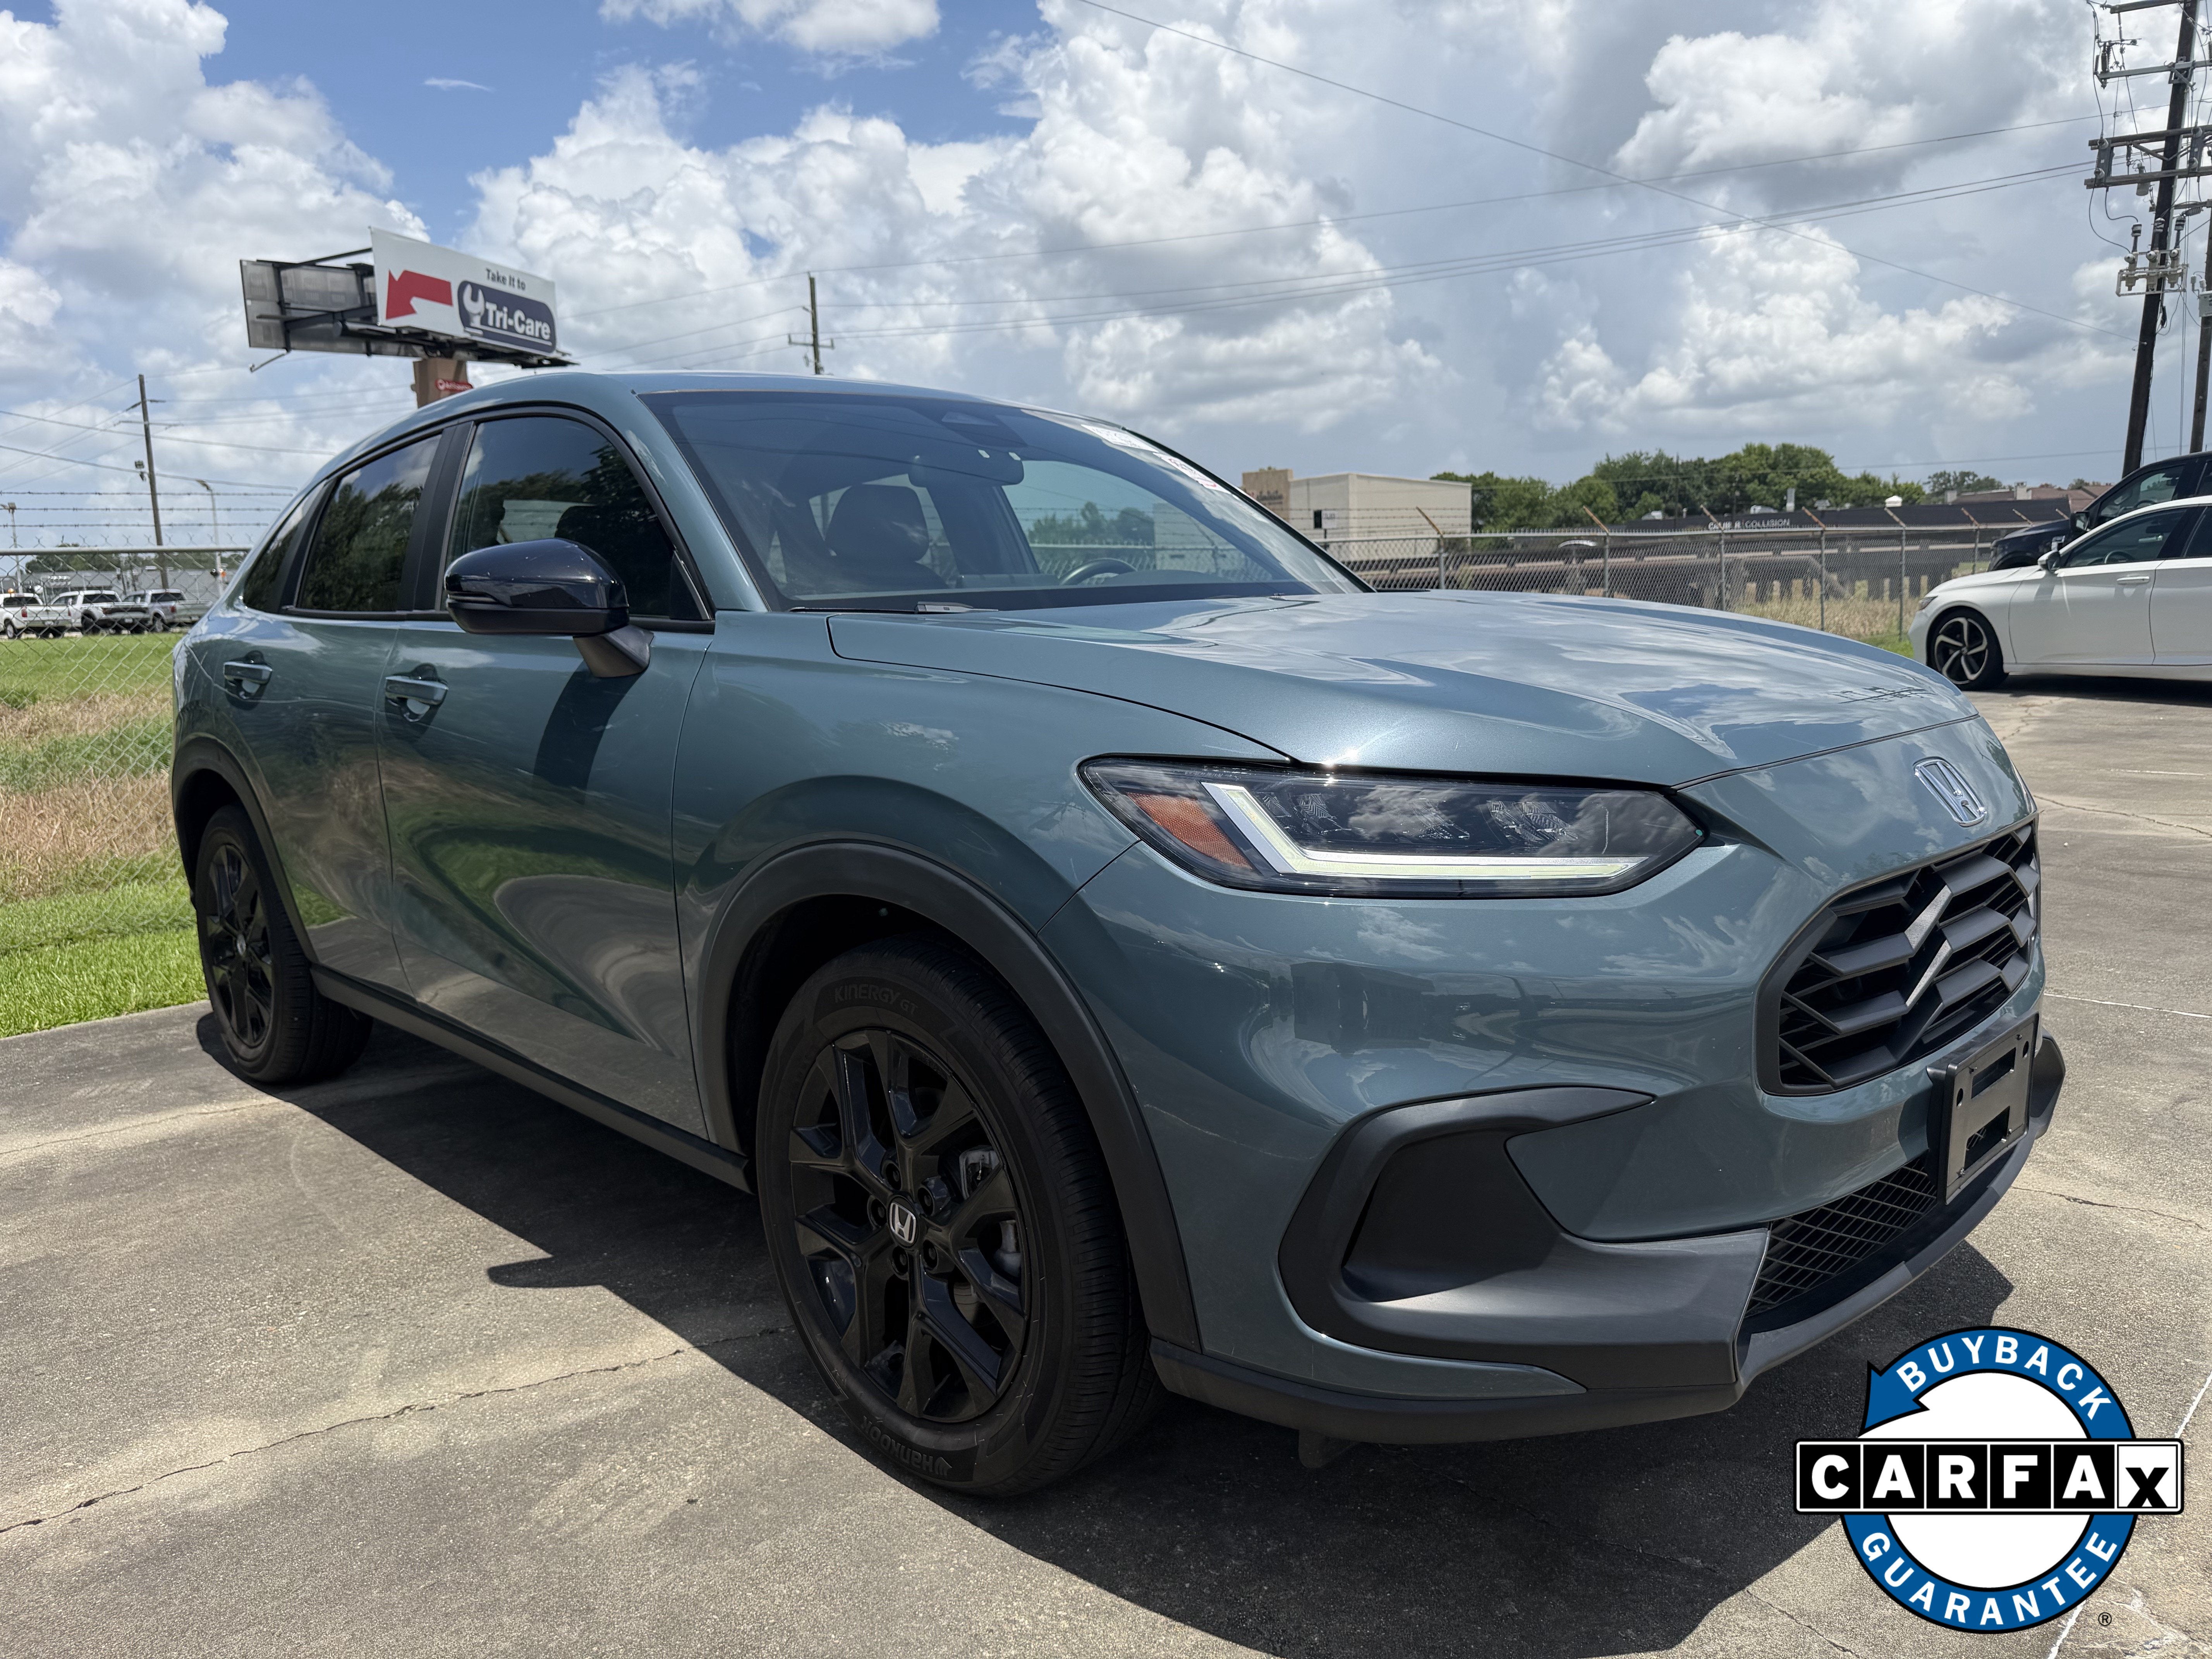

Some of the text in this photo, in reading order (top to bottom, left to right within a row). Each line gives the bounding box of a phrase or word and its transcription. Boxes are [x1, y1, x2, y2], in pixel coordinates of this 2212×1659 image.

[486, 268, 507, 284] Take
[517, 277, 526, 290] to
[486, 302, 551, 340] Tri-Care
[1709, 519, 1790, 530] CAIBR COLLISION
[901, 999, 918, 1014] GT
